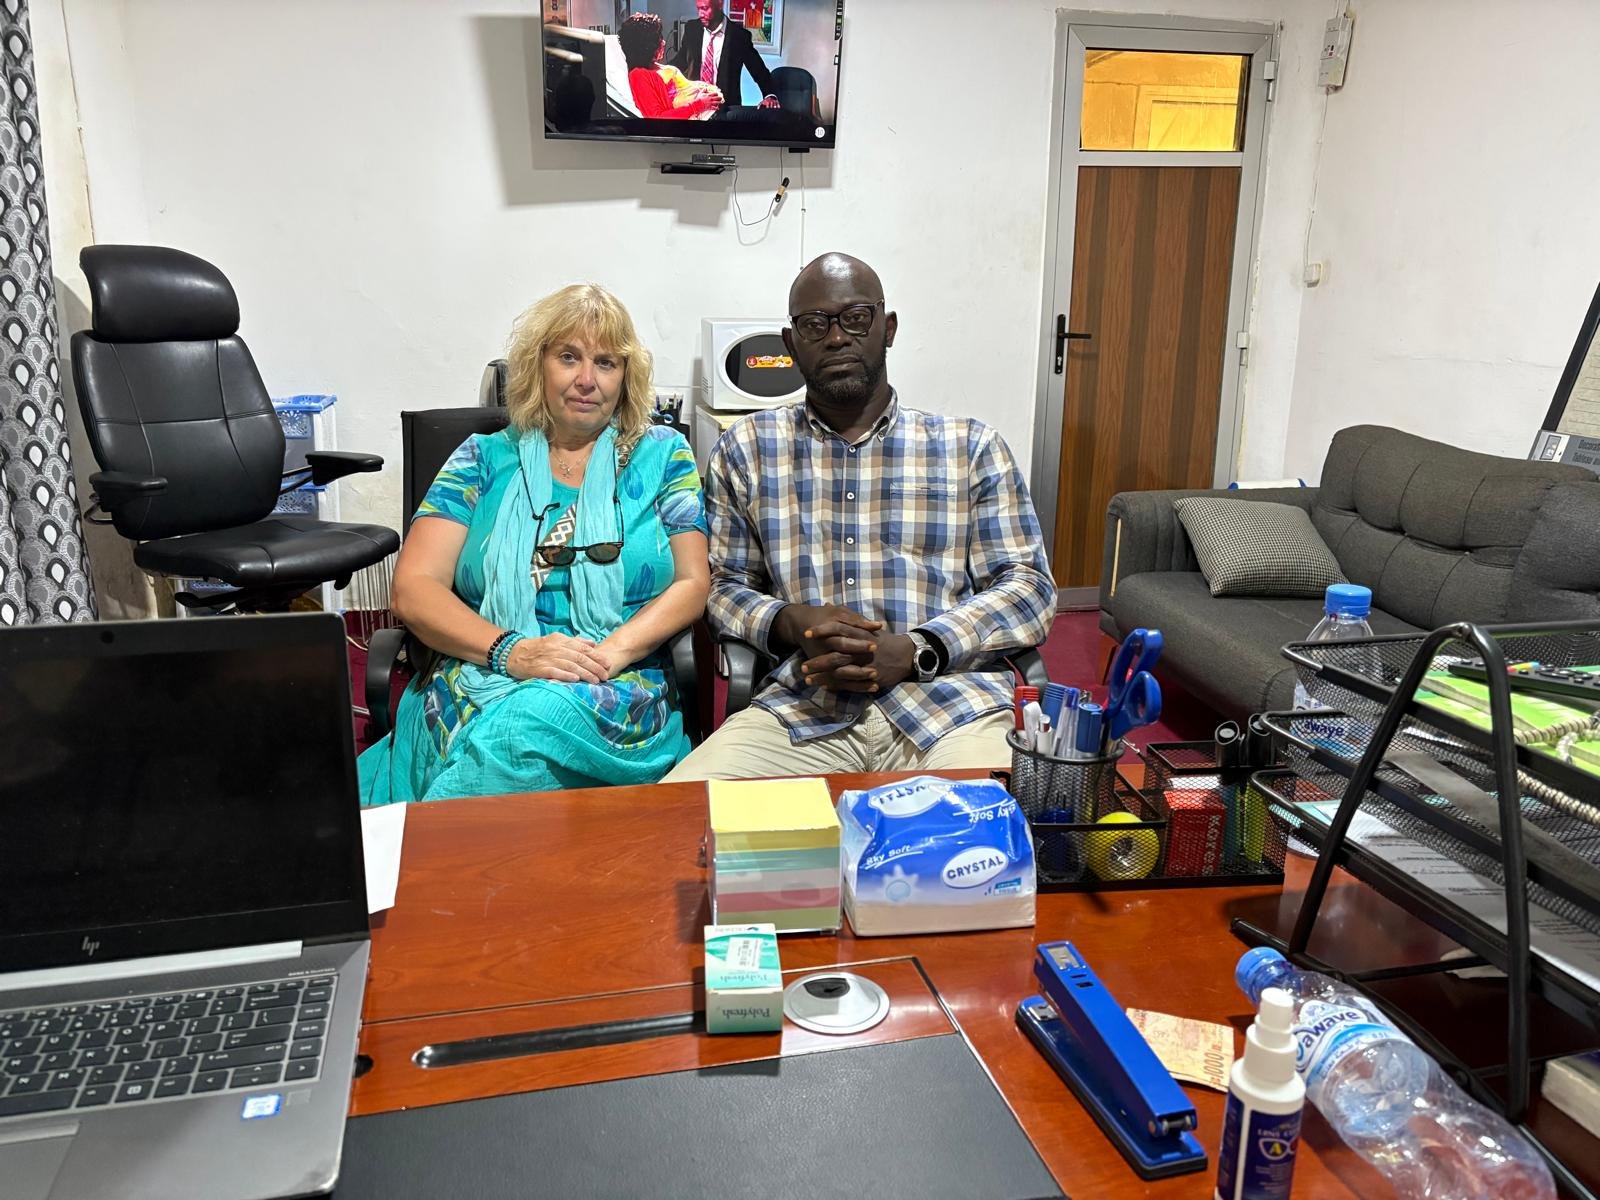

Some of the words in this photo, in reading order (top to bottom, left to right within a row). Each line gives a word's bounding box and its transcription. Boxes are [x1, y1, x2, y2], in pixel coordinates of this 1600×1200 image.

[946, 855, 1004, 879] CRYSTAL
[82, 936, 100, 956] hp
[722, 1007, 771, 1019] Polyfresh
